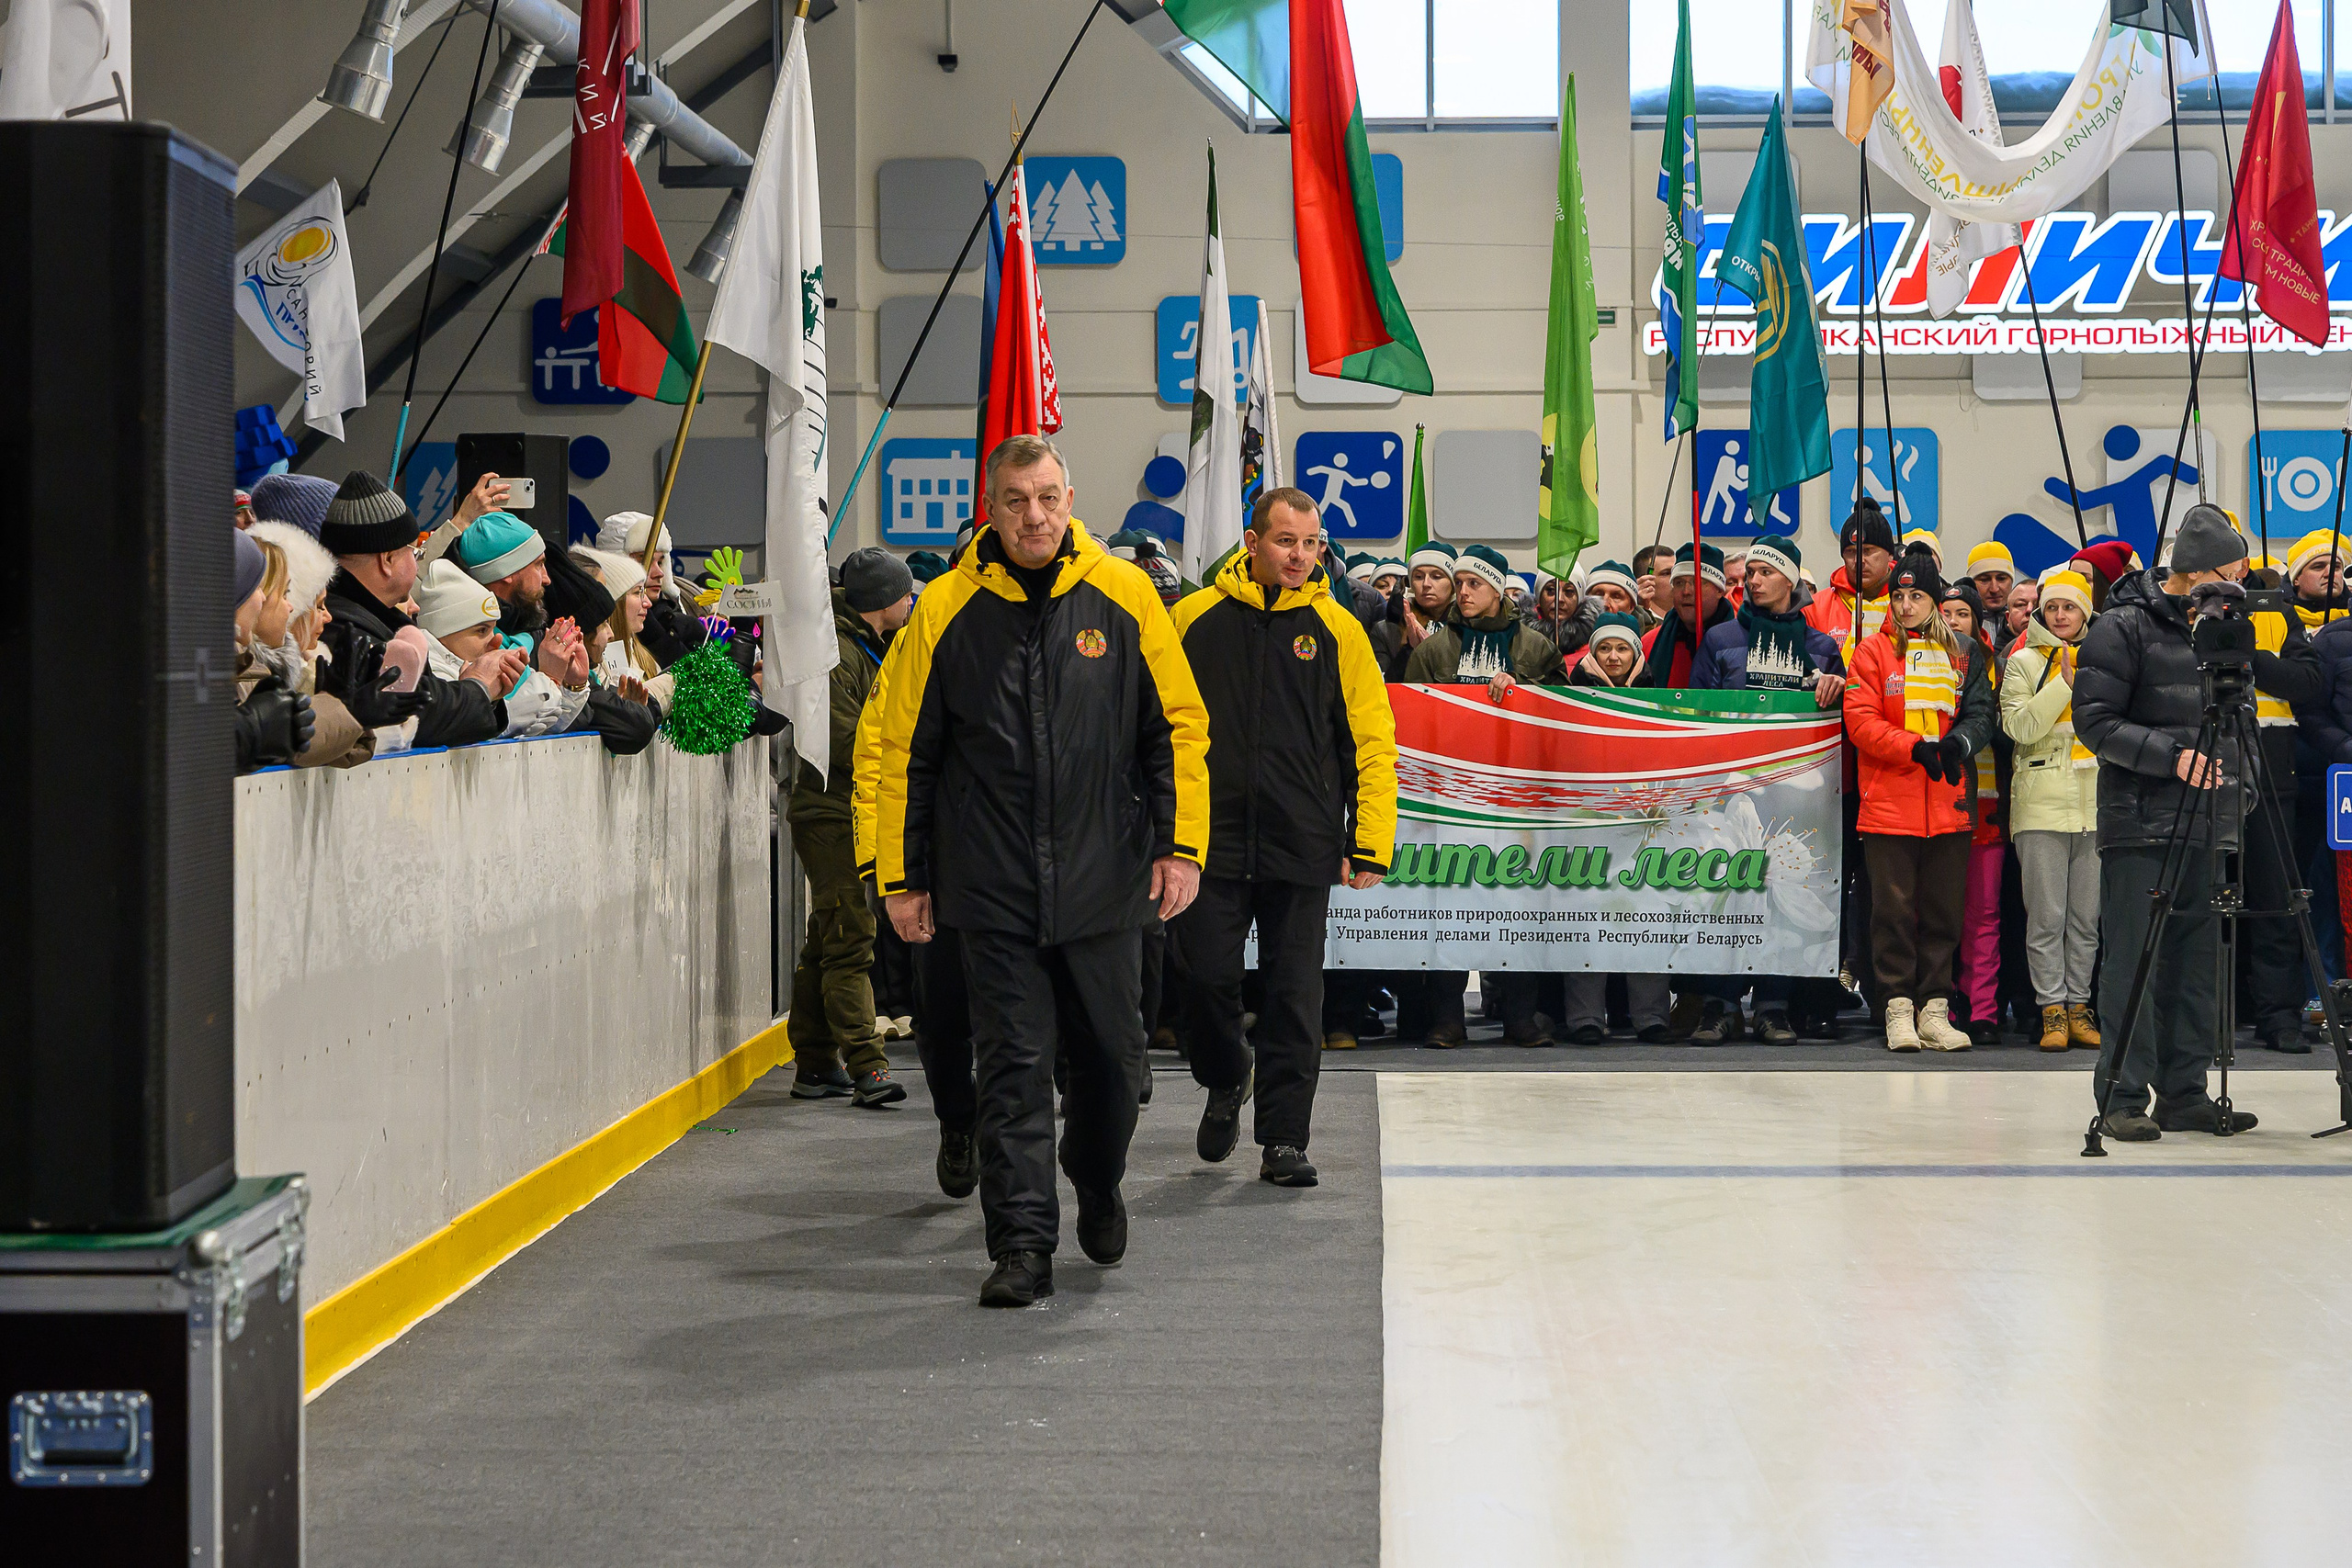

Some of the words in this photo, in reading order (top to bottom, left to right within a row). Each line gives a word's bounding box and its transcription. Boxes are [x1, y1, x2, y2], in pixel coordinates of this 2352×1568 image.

[2278, 272, 2321, 305] НОВЫЕ
[1749, 548, 1786, 568] БЕЛАРУСЬ
[1473, 561, 1502, 585] БЕЛАРУСЬ
[726, 598, 772, 610] СОСНЫ
[1749, 672, 1800, 683] ХРАНИТЕЛИ
[1618, 846, 1767, 889] леса
[1364, 905, 1453, 921] работников
[1455, 908, 1597, 924] природоохранных
[1600, 911, 1610, 922] и
[1613, 909, 1764, 925] лесохозяйственных
[1336, 926, 1429, 942] Управления
[1435, 929, 1490, 942] делами
[1498, 928, 1590, 944] Президента
[1598, 929, 1689, 946] Республики
[1696, 931, 1763, 948] Беларусь
